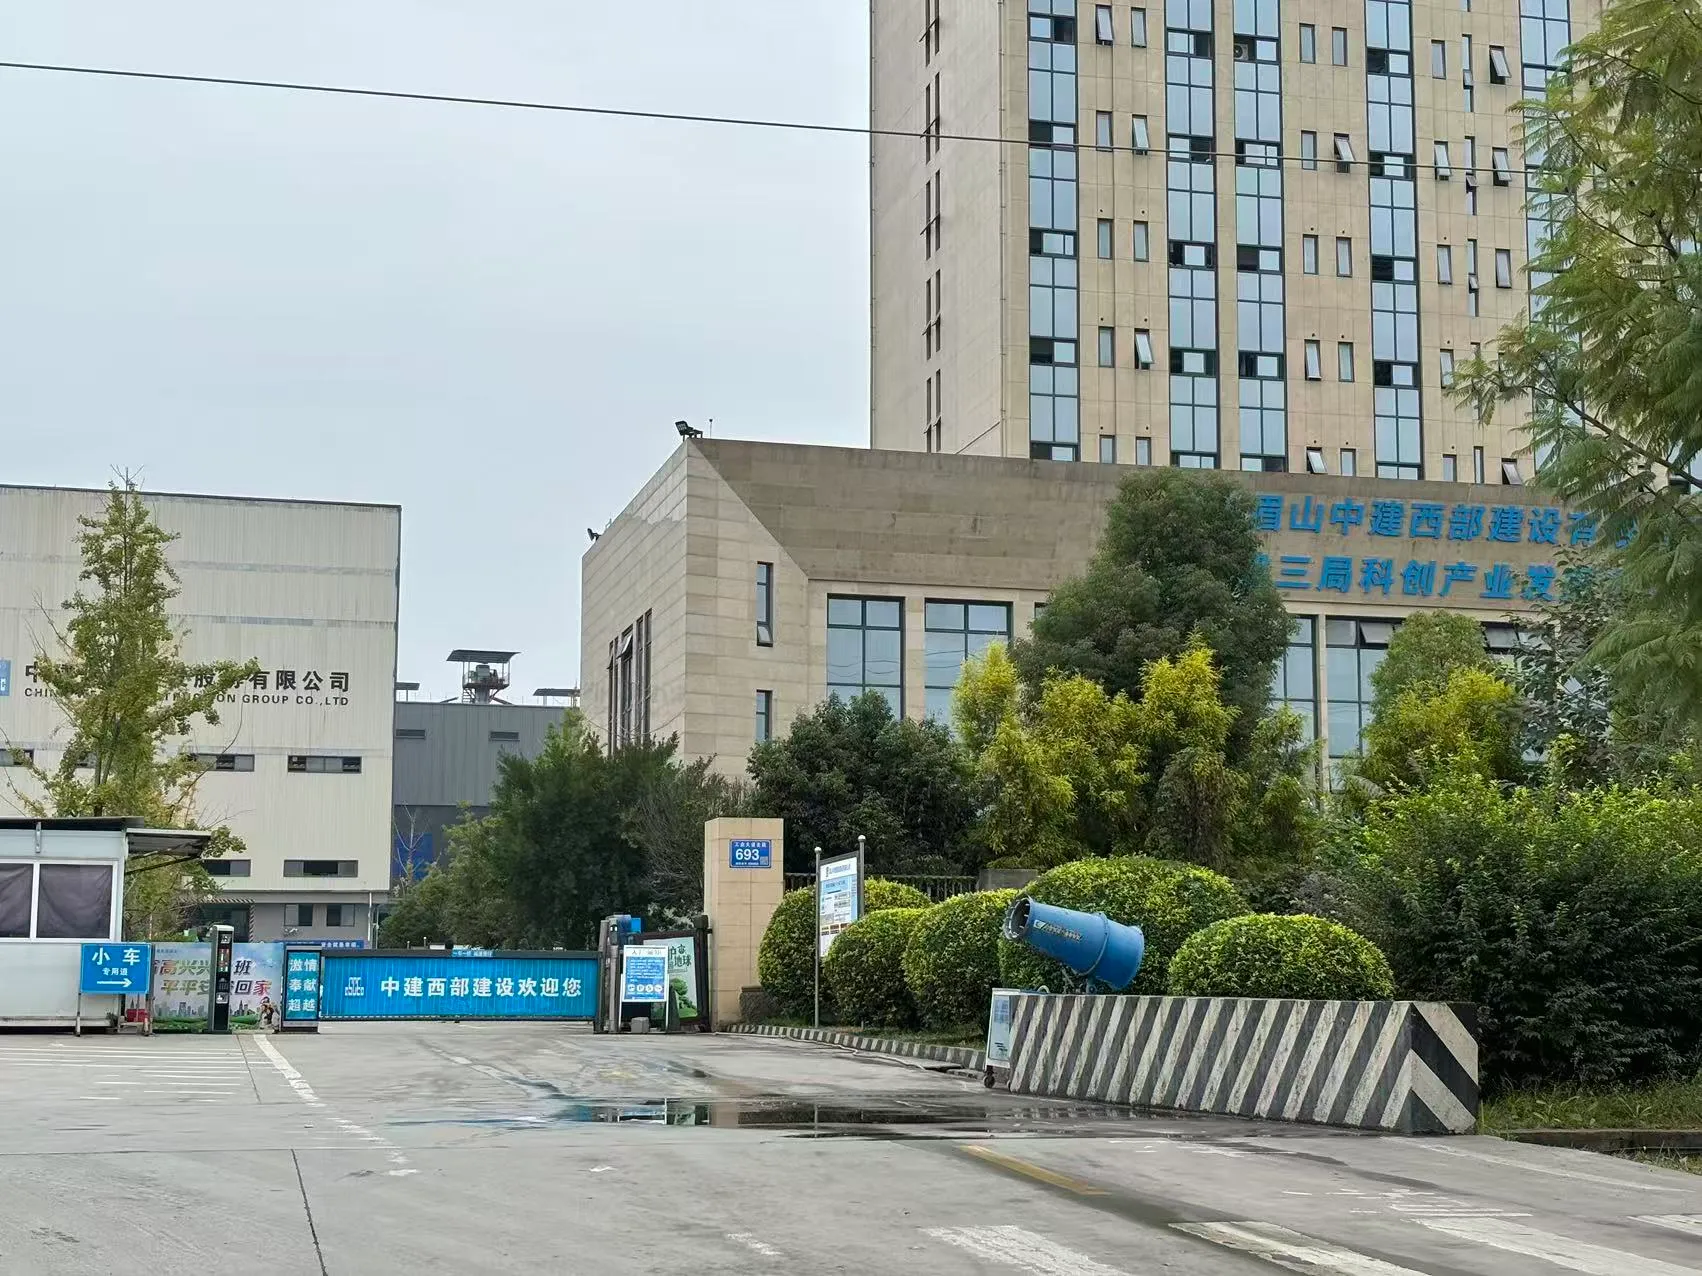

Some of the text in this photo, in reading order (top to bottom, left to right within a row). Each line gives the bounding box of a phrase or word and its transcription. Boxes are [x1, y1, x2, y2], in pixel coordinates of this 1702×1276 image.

[242, 694, 288, 704] GROUP
[296, 695, 349, 706] CO.,LTD
[735, 848, 760, 861] 693
[92, 948, 140, 966] 小车
[289, 958, 318, 971] 激情
[102, 967, 128, 976] 专用道
[288, 978, 317, 992] 奉献
[380, 976, 582, 998] 中建西部建设欢迎您
[287, 998, 316, 1011] 超越
